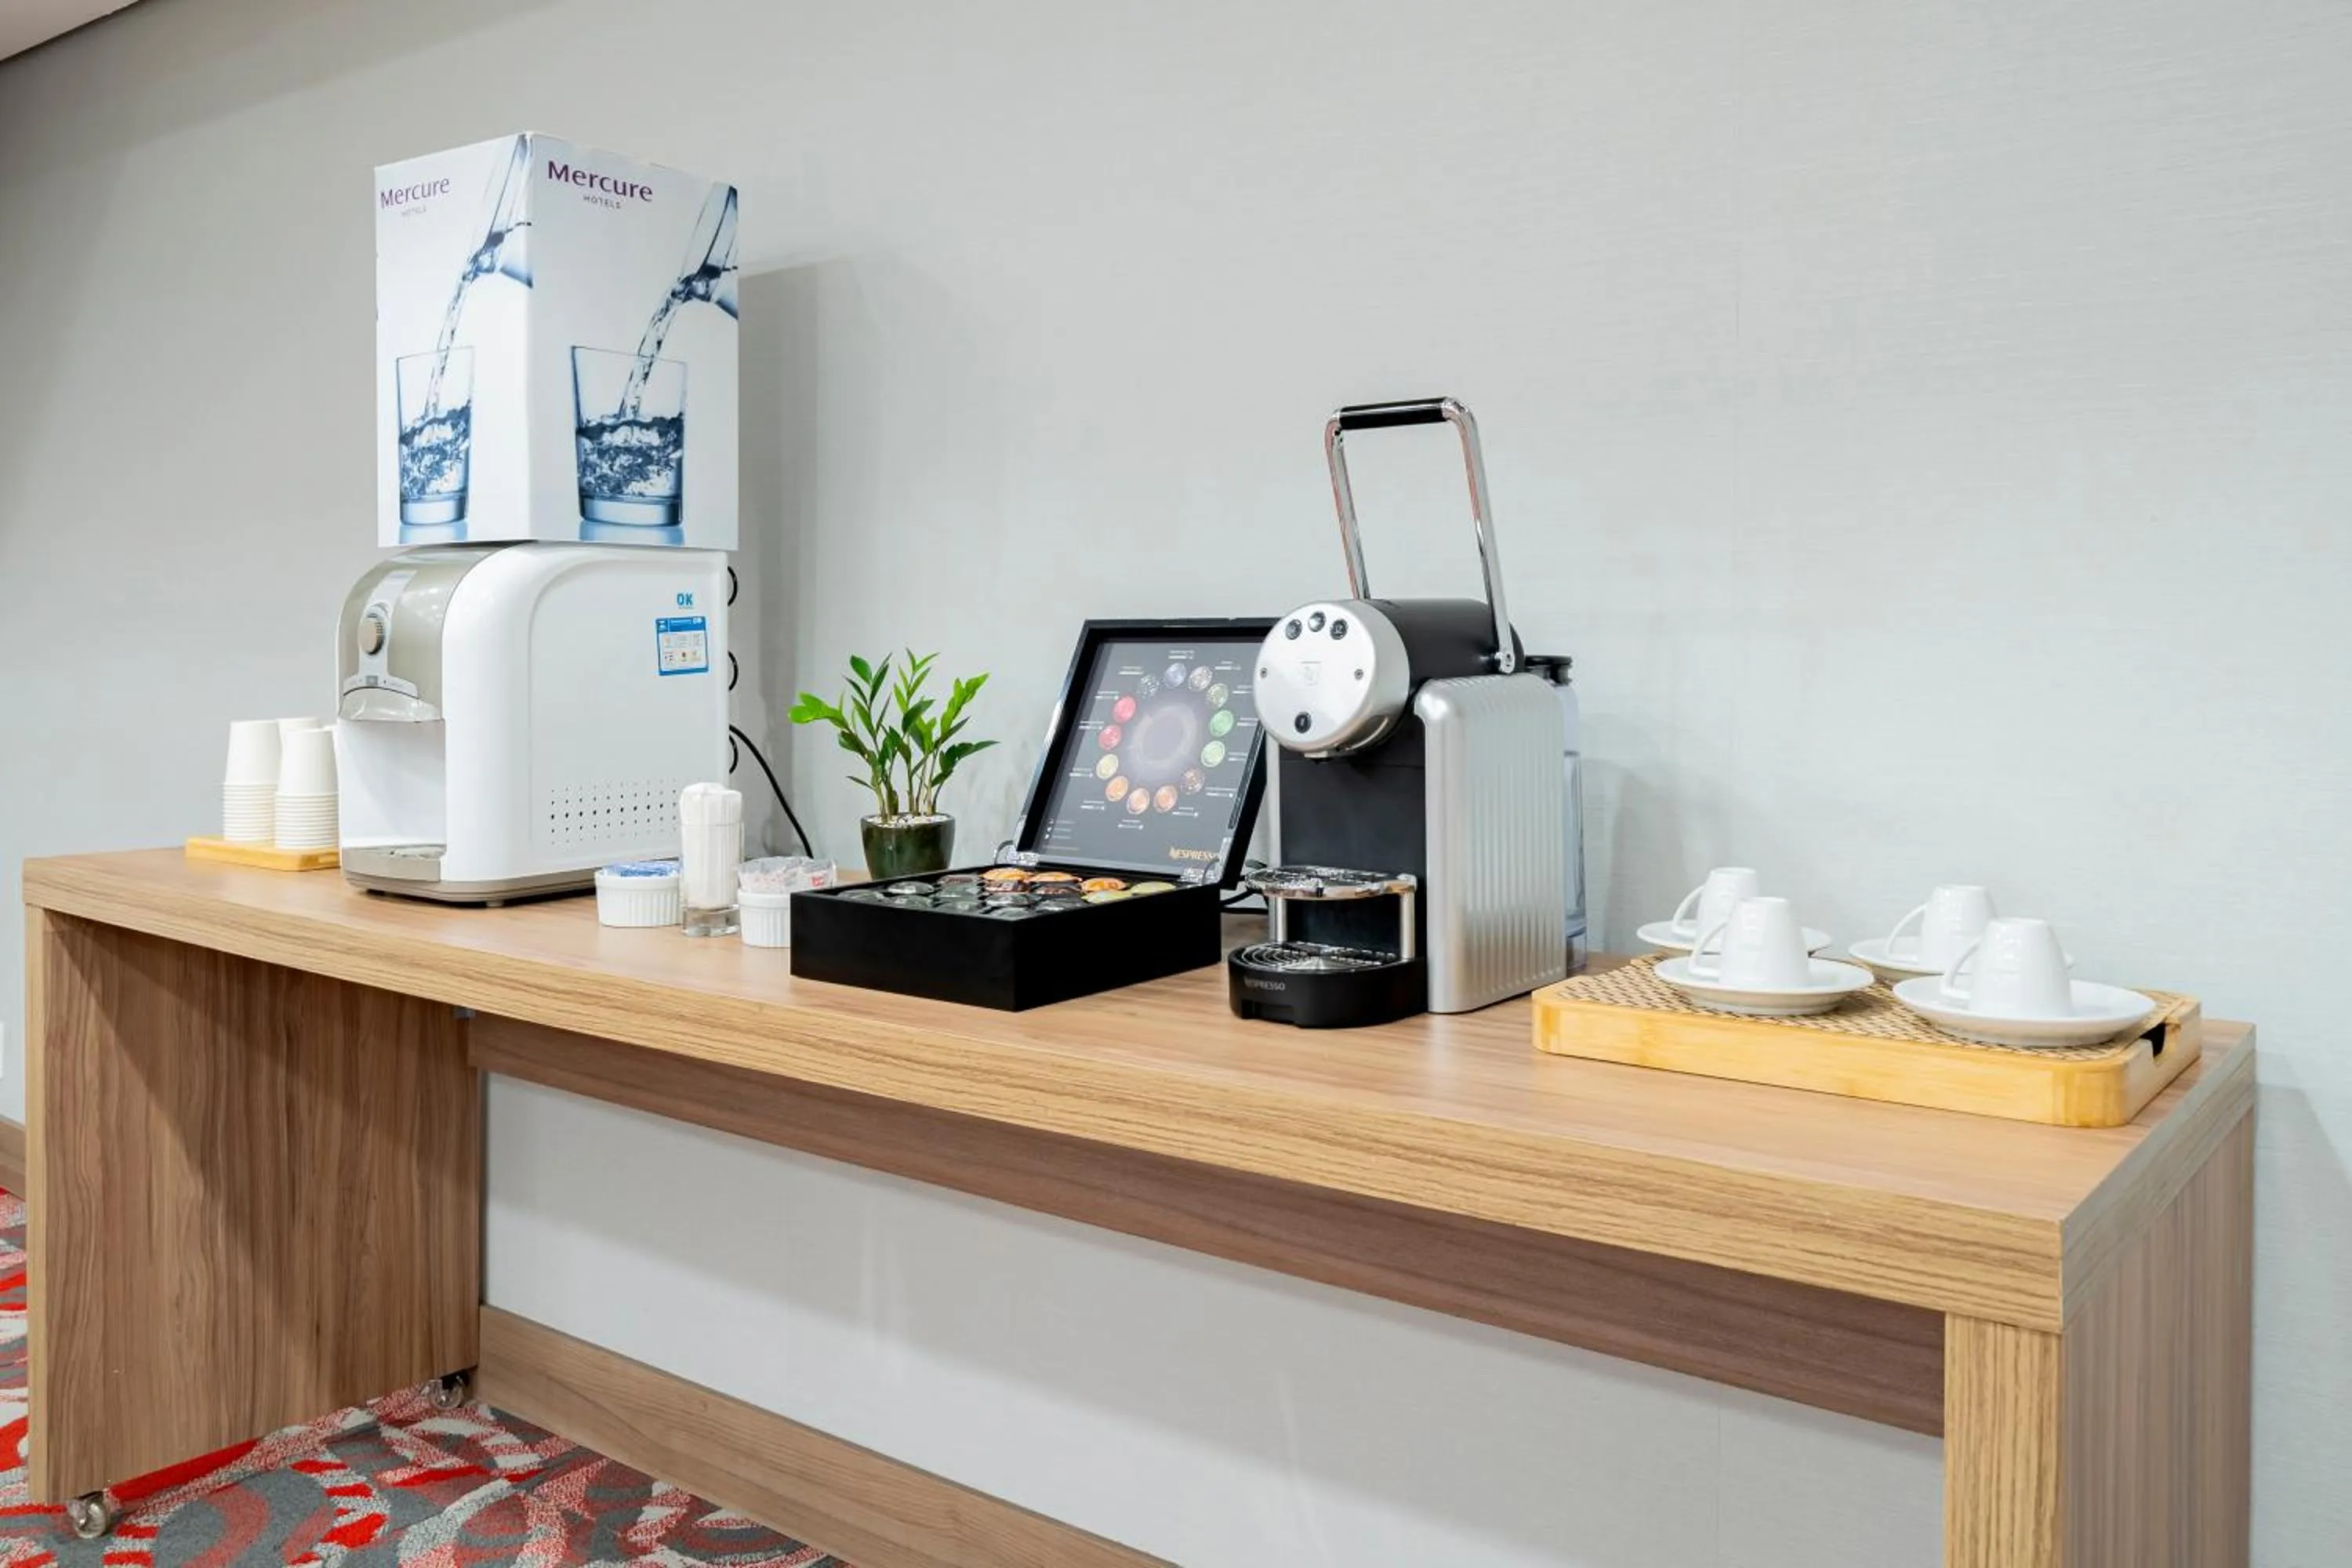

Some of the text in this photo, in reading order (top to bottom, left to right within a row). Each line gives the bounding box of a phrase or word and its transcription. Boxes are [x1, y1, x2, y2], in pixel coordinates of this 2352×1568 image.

[547, 160, 653, 202] Mercure
[380, 178, 449, 209] Mercure
[583, 194, 622, 209] HOTELS
[677, 593, 693, 606] OK
